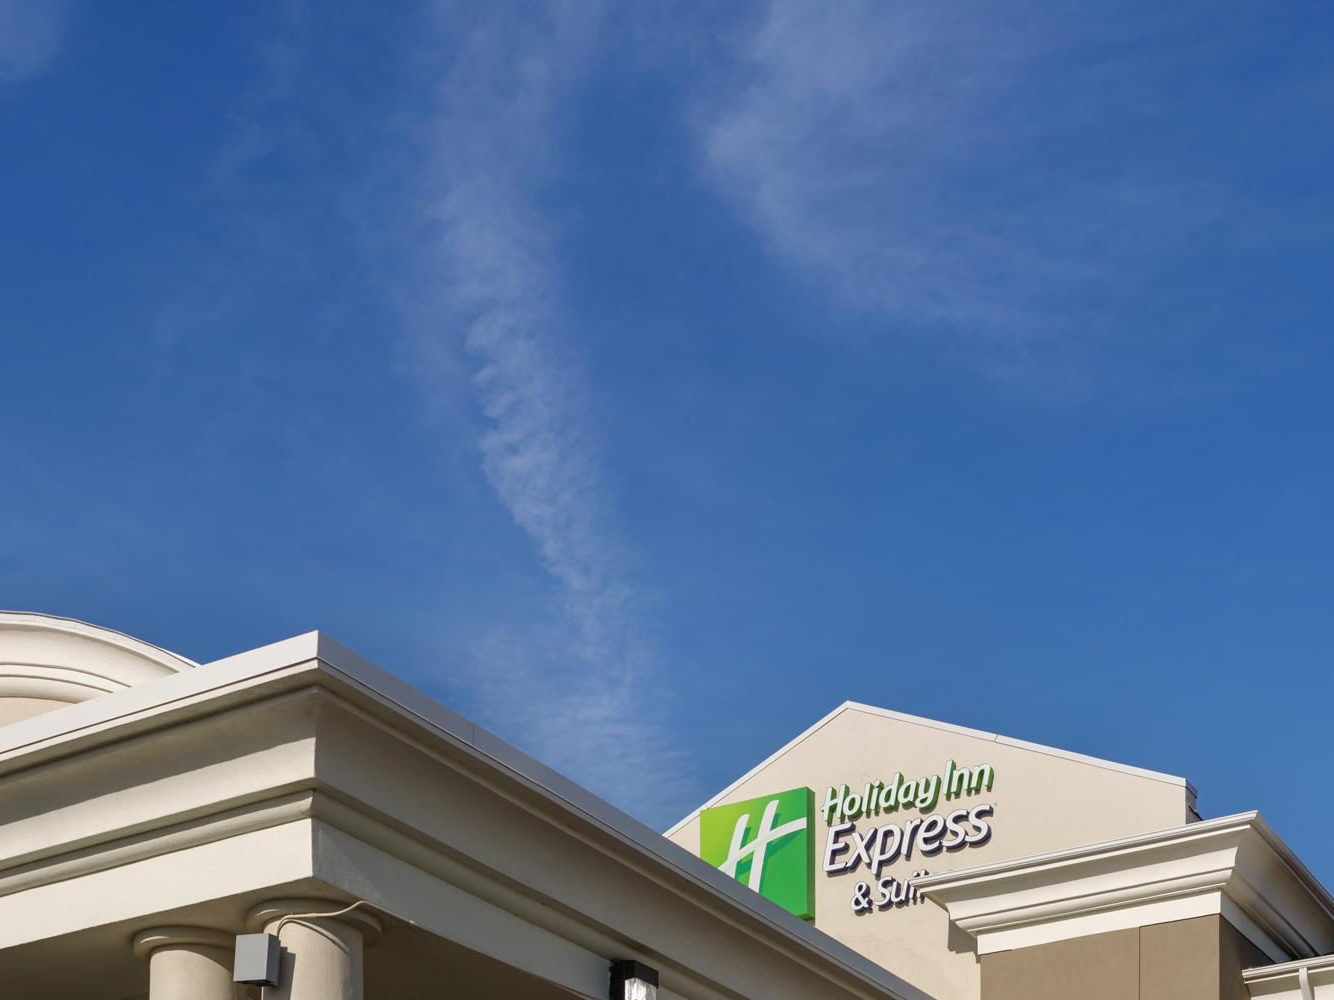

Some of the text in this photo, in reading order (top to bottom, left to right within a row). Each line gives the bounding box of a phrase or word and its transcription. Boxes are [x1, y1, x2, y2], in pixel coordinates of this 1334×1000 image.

[822, 759, 994, 823] Holiday Inn
[823, 804, 994, 878] Express
[851, 881, 871, 912] &
